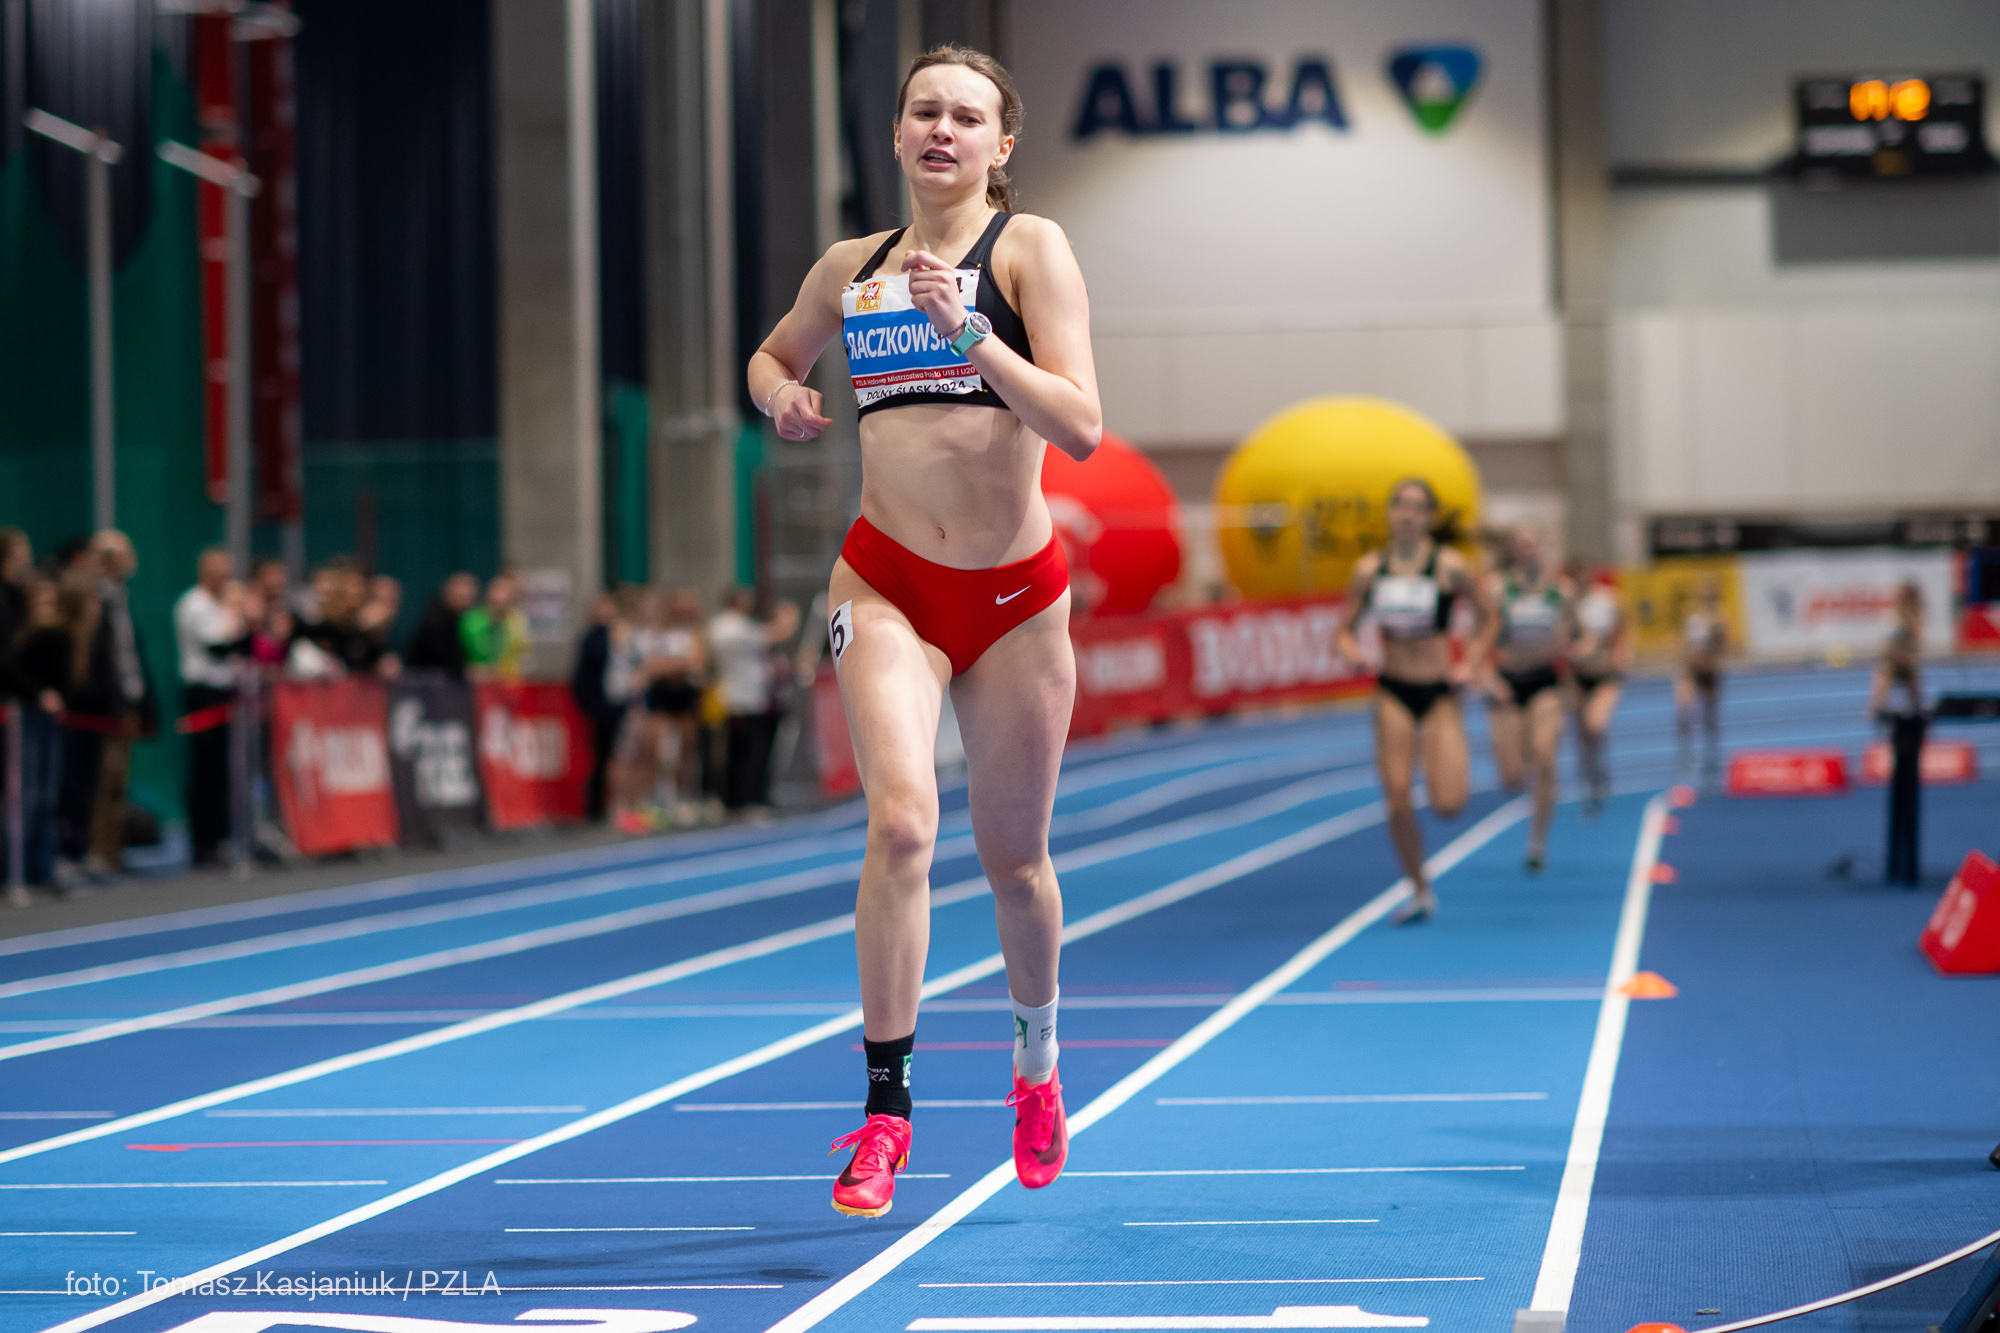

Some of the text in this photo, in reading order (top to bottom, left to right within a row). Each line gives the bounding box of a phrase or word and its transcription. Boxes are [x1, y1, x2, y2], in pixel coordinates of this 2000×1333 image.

[1074, 60, 1349, 136] ALBA
[857, 300, 879, 310] PZLA
[942, 369, 955, 377] U18
[961, 367, 976, 375] U20
[934, 380, 966, 393] 2024
[831, 609, 846, 658] 5
